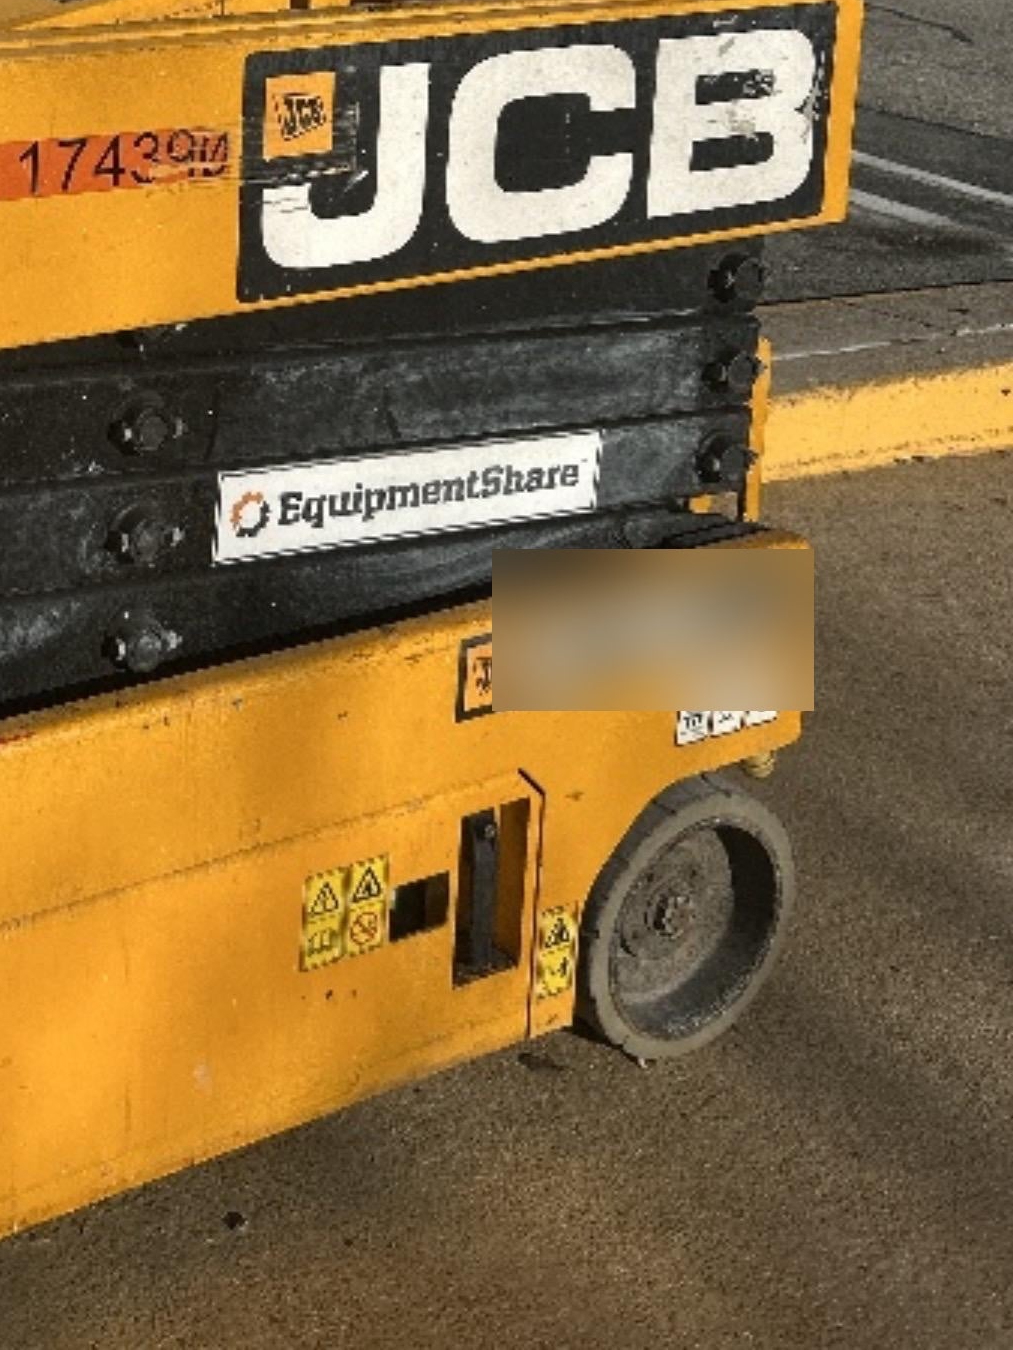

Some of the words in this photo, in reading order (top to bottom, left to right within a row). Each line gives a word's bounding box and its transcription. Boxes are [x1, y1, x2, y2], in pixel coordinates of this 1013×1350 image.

[260, 29, 817, 270] JCB
[278, 95, 324, 139] JCB
[277, 464, 581, 529] EquipmentShare
